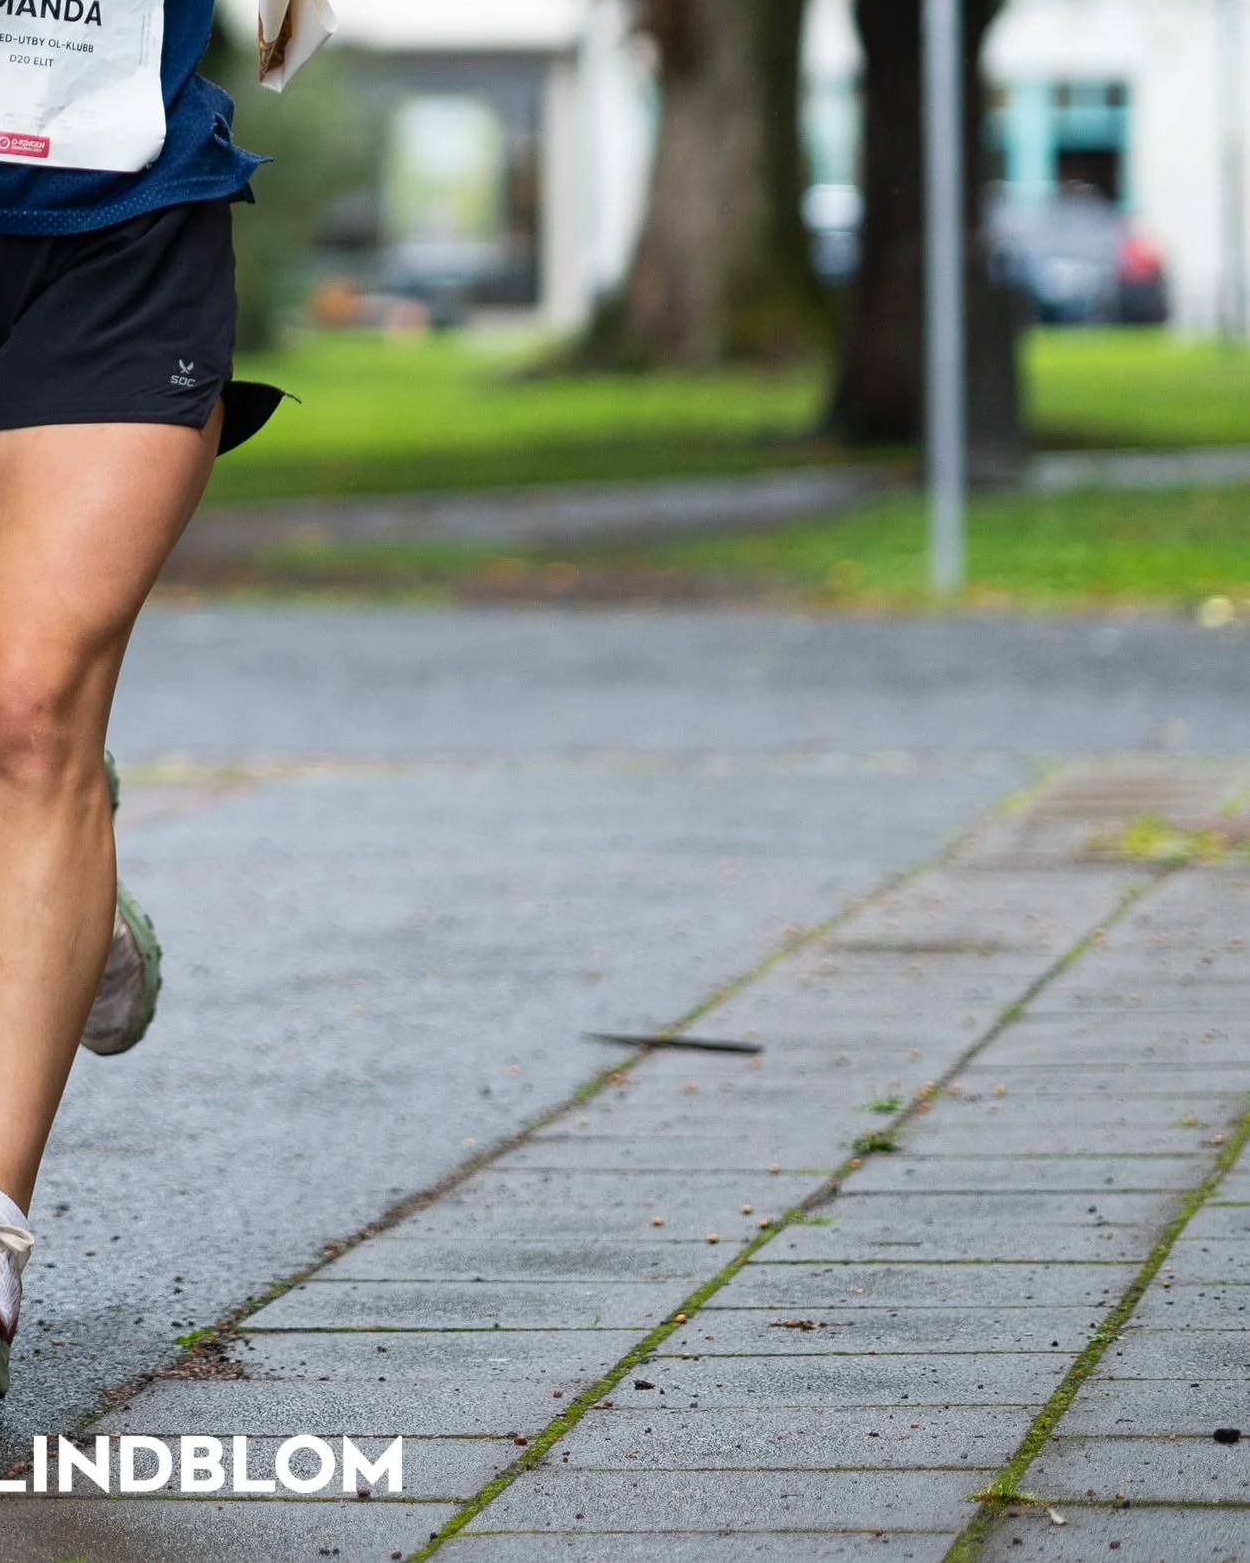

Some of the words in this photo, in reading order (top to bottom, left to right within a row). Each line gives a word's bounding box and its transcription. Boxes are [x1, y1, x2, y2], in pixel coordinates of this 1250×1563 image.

[48, 39, 94, 53] OL-KLUBB
[9, 54, 31, 64] D20
[33, 57, 54, 67] ELIT
[170, 374, 196, 387] SOC
